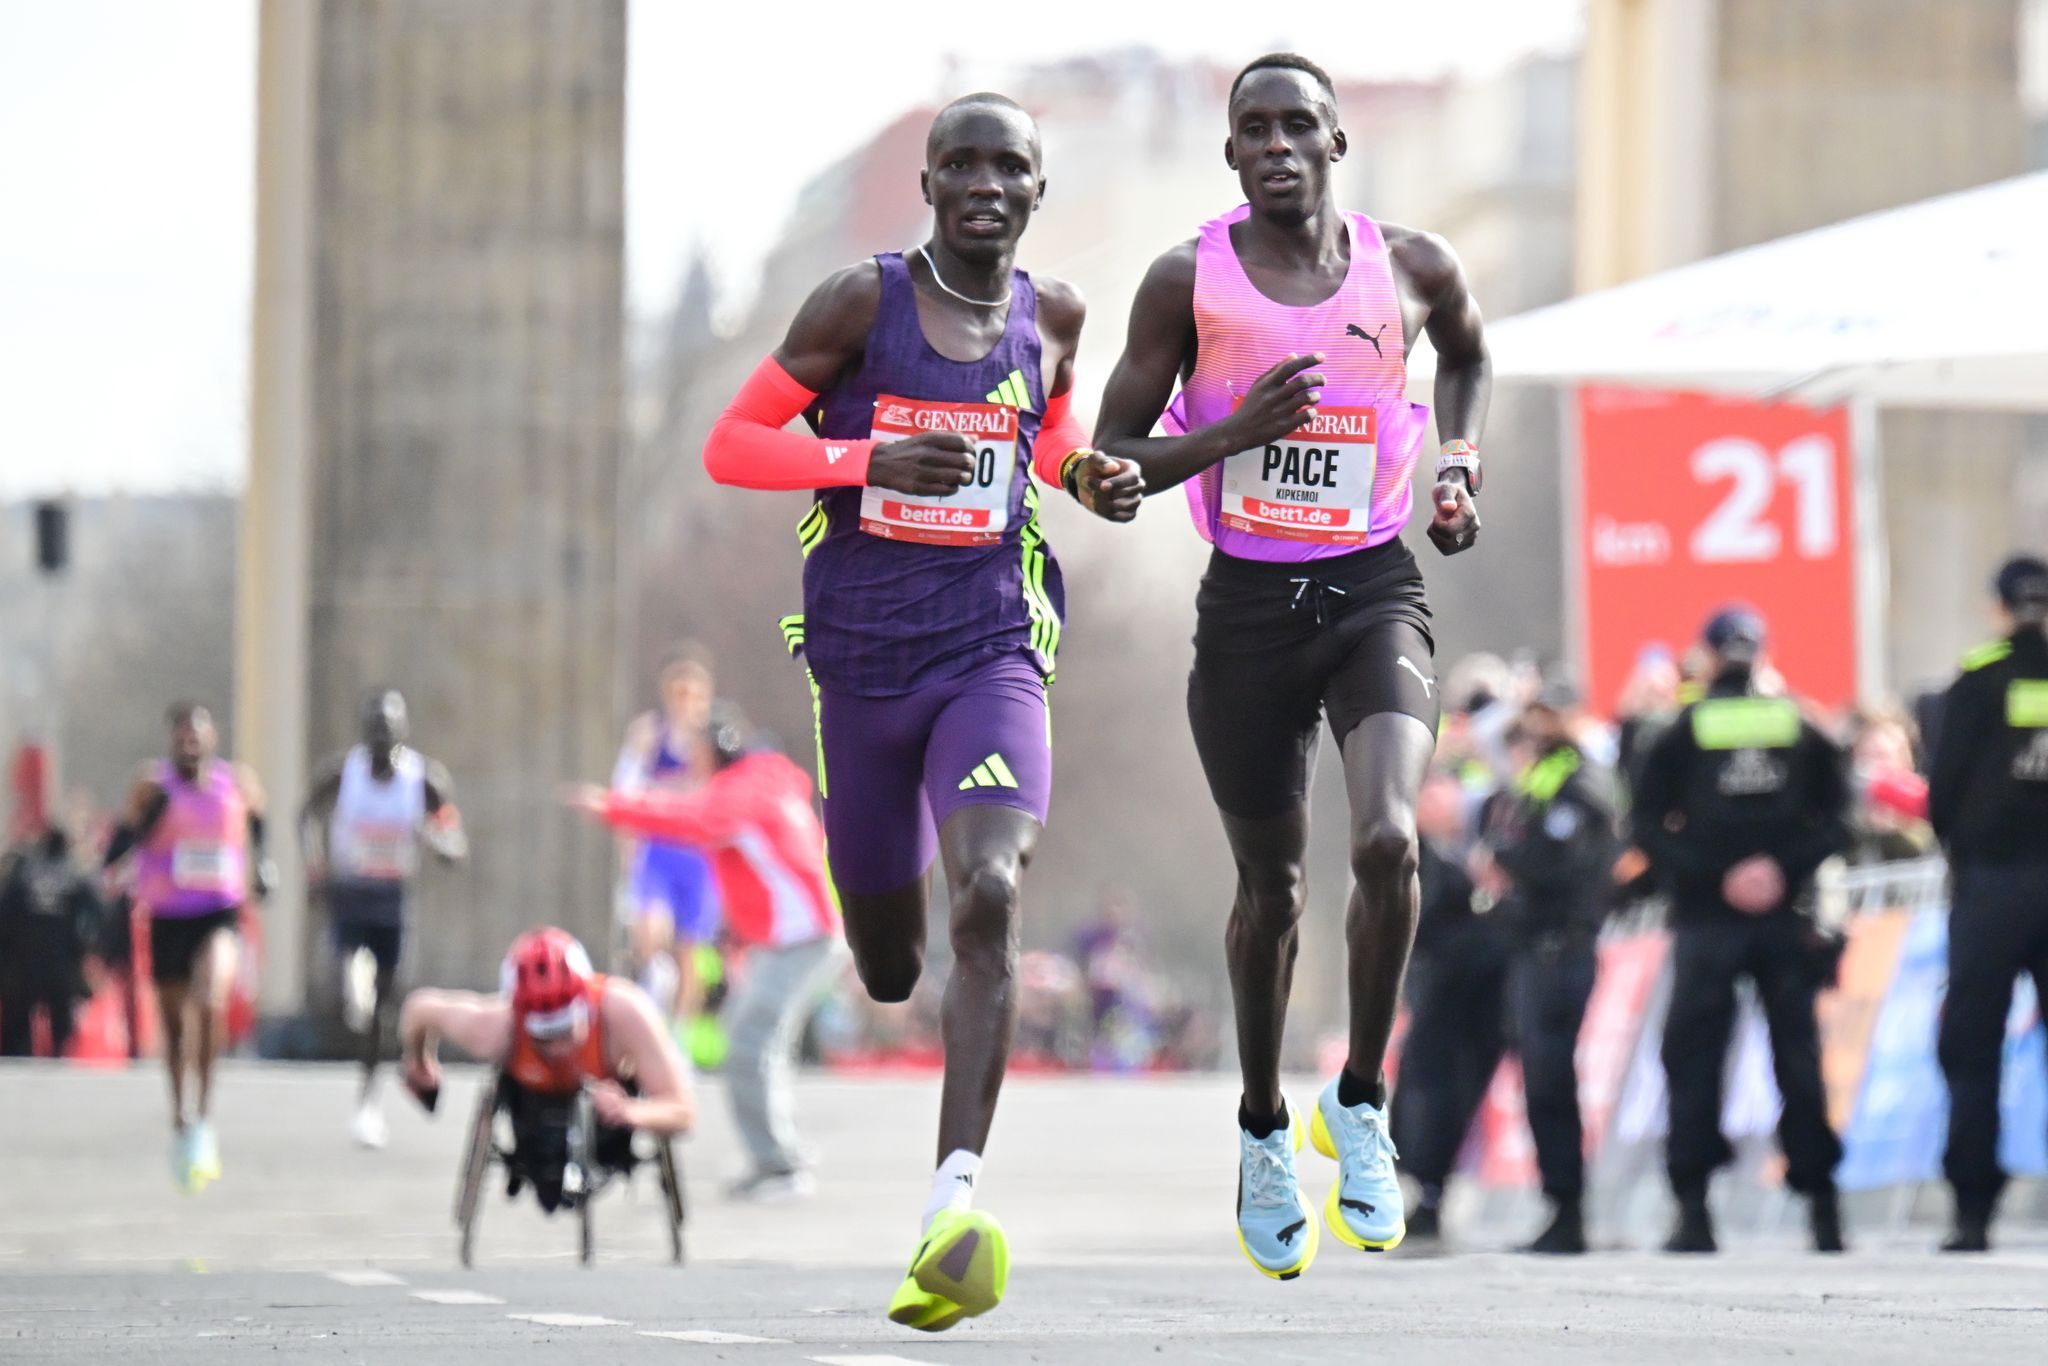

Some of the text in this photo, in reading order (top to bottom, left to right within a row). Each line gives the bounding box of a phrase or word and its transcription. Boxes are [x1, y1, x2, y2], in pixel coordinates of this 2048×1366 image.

[914, 409, 1011, 434] GENERALI
[1261, 445, 1339, 488] PACE
[1275, 488, 1319, 503] KIPKEMOI
[1593, 434, 1838, 565] km 21
[900, 505, 973, 524] bett1.de
[1259, 502, 1332, 524] bett1.de
